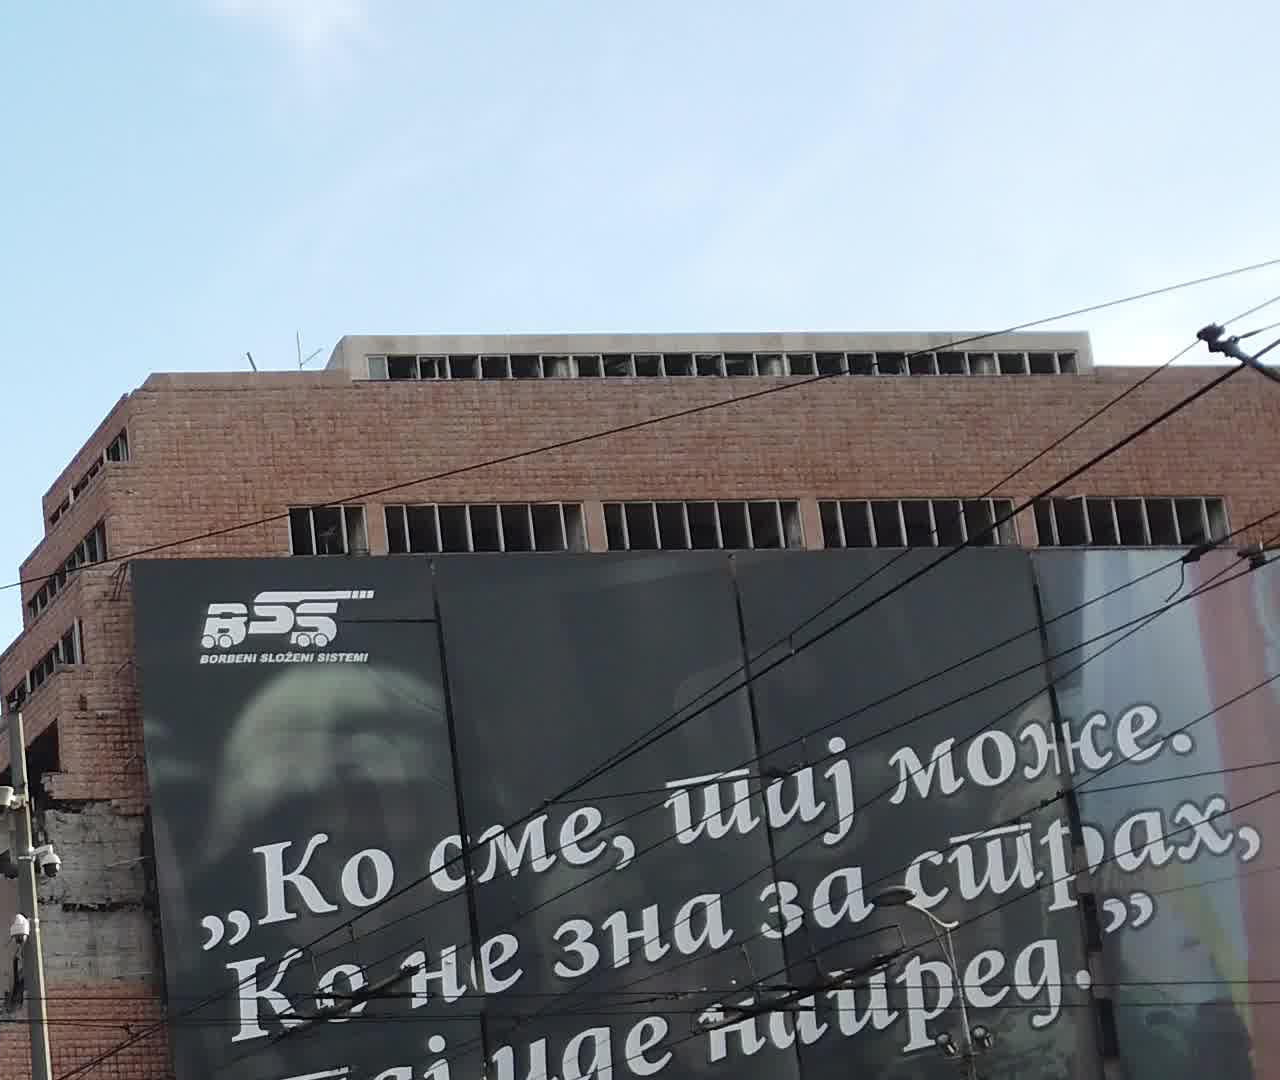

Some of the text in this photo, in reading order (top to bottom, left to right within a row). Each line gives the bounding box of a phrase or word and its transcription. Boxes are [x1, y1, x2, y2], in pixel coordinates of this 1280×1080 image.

[200, 651, 369, 664] BORBENI SLOŽENI SISTEMI
[429, 800, 634, 894] сме,
[890, 700, 1193, 805] може.
[224, 946, 367, 1042] Ко
[405, 930, 523, 1000] не
[553, 889, 731, 980] зна
[760, 861, 876, 940] за
